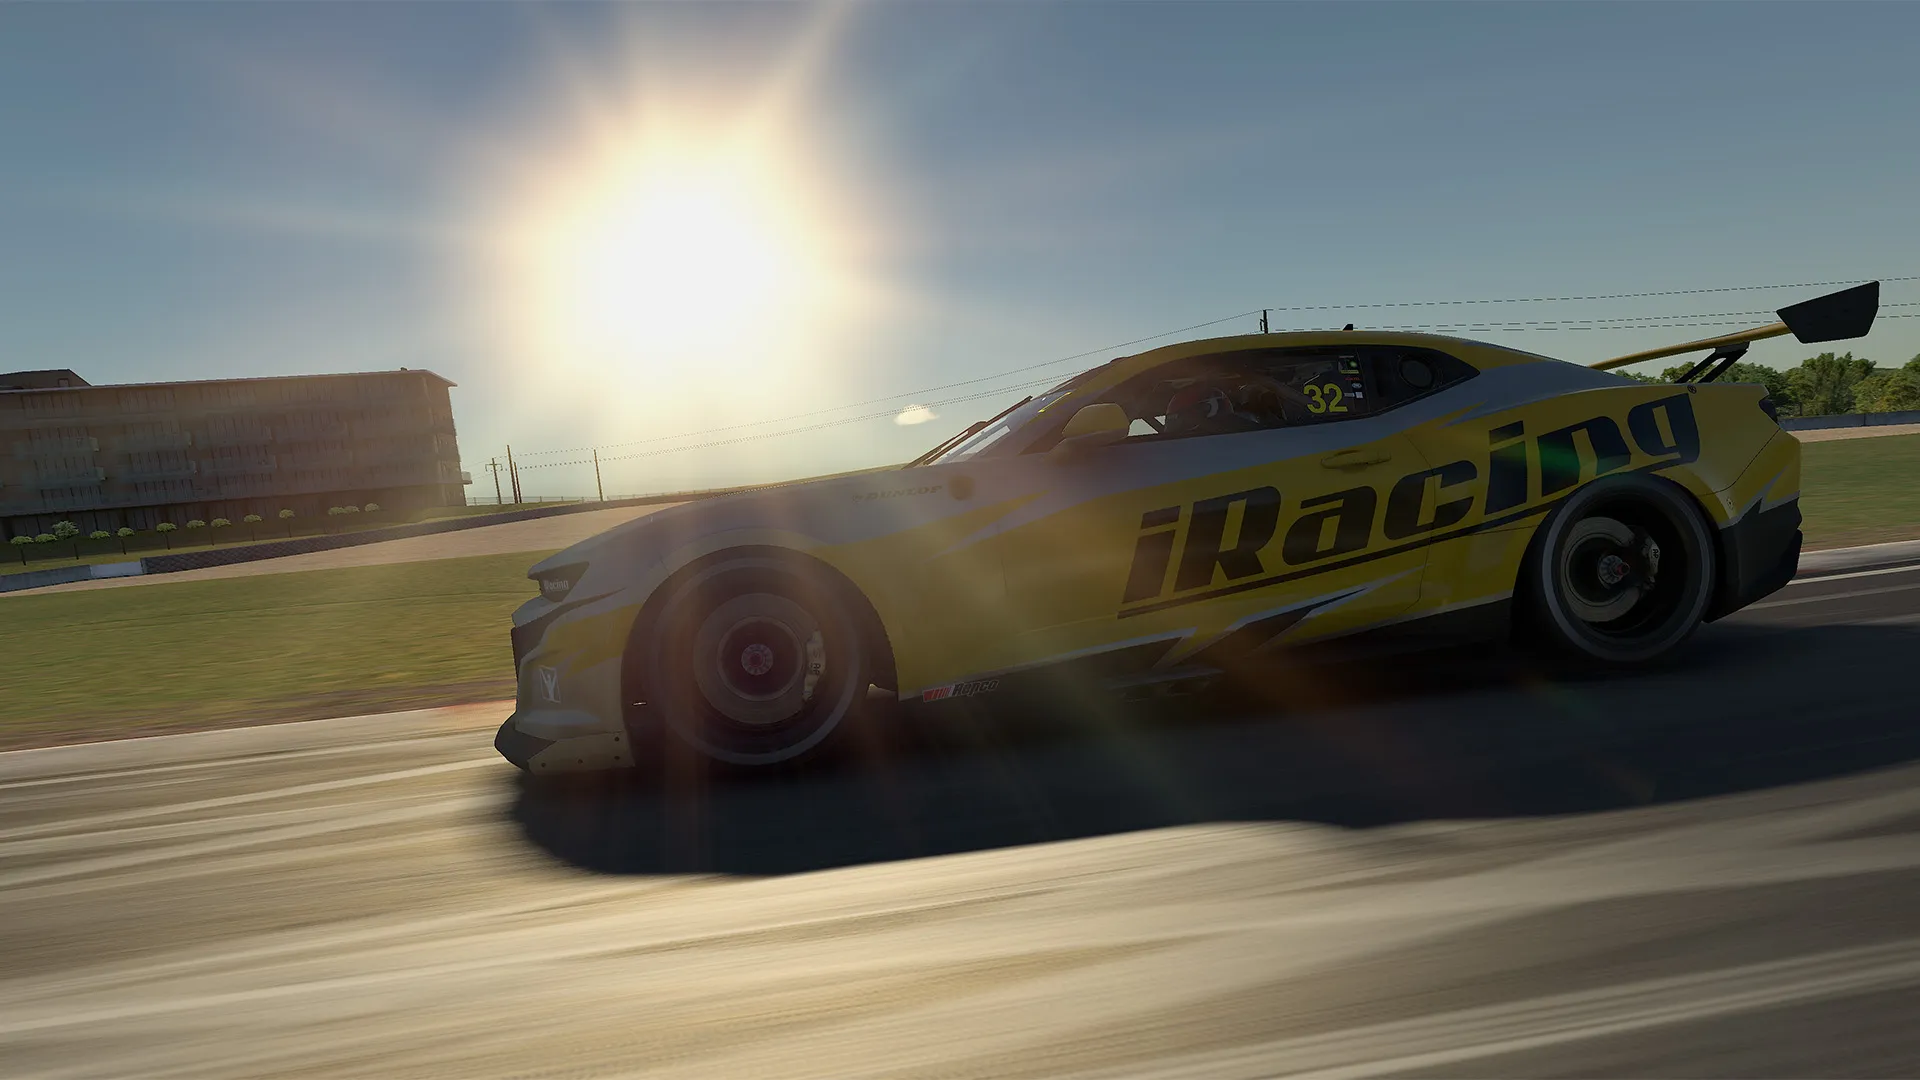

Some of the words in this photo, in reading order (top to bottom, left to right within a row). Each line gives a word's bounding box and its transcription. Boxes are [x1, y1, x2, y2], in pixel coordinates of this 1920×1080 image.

[1303, 383, 1348, 413] 32
[863, 485, 943, 501] DUNLOP
[1121, 393, 1700, 603] iRacing
[952, 679, 999, 697] Repco
